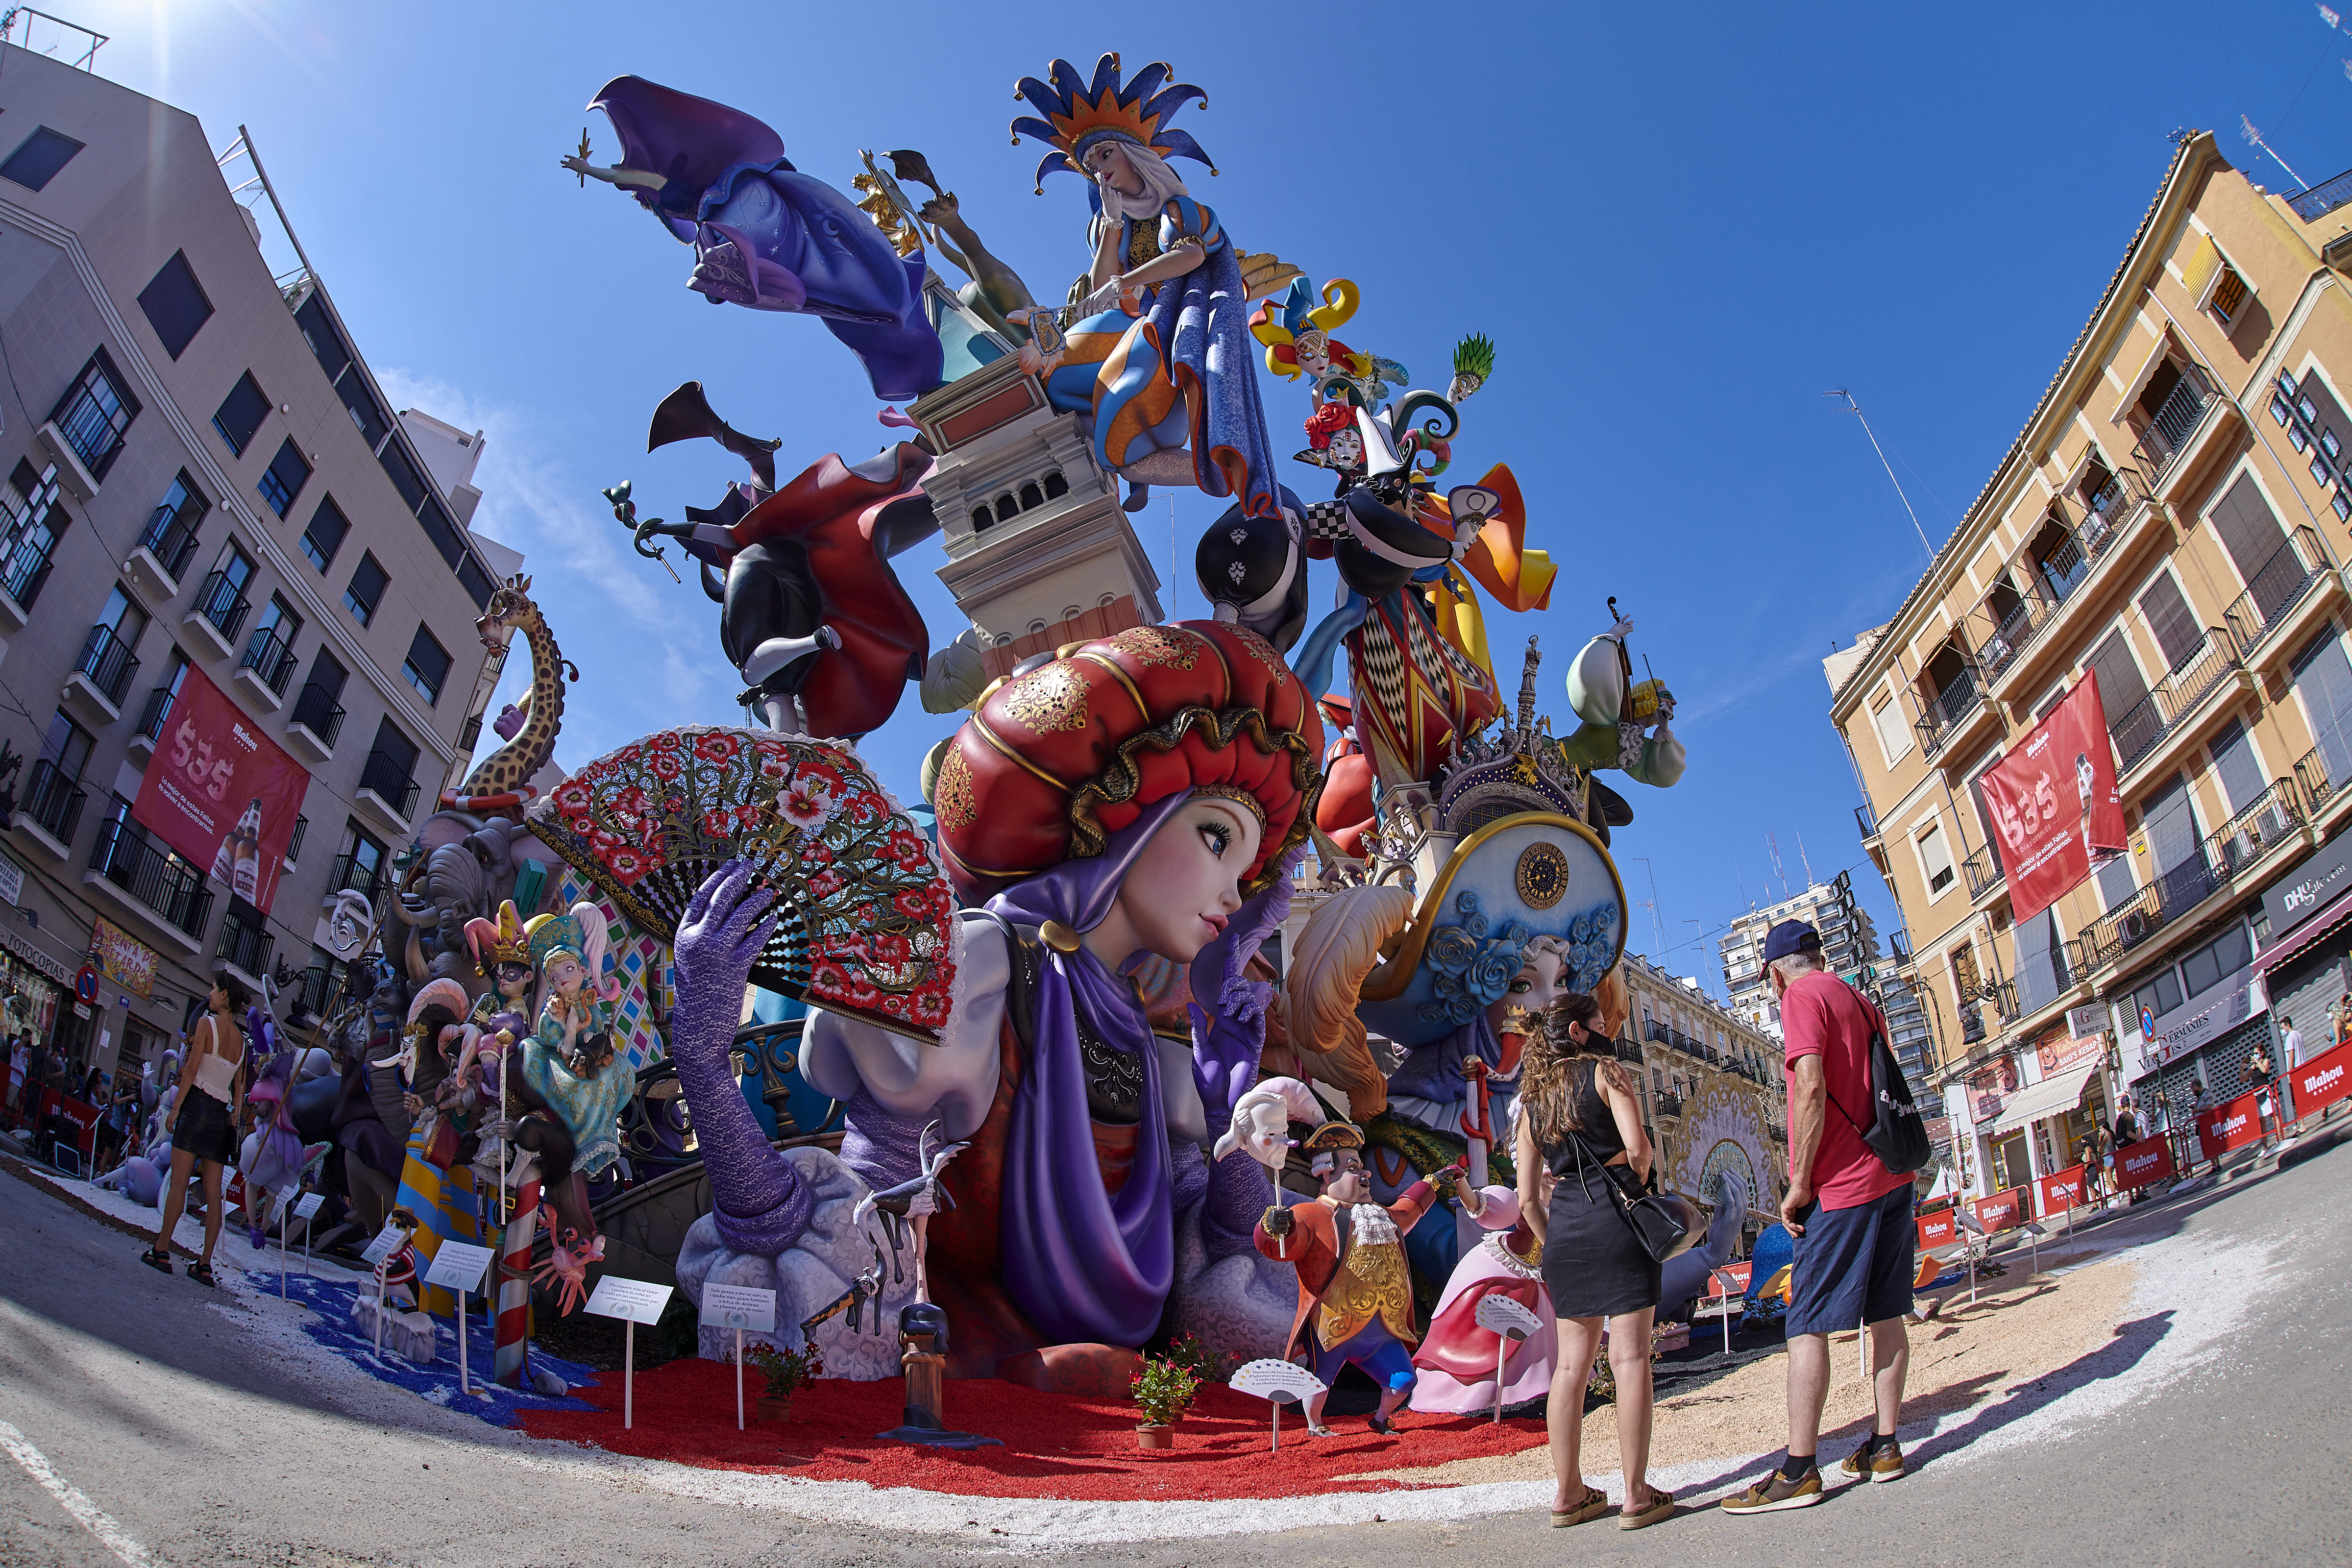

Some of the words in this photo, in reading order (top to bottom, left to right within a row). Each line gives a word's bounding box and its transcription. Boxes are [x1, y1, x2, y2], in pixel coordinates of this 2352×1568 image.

[233, 723, 257, 751] Mahou
[2027, 731, 2049, 758] Mahou
[171, 717, 233, 801] 535
[174, 770, 185, 784] DÍAS
[187, 782, 207, 803] DESPUÉS
[163, 787, 177, 805] volver
[181, 805, 214, 835] encontrarnos.
[167, 781, 180, 797] mejor
[180, 793, 187, 803] de
[187, 800, 200, 814] estas
[200, 810, 214, 826] Fallas
[2002, 771, 2058, 848] 535
[2016, 864, 2021, 874] Lo
[2021, 855, 2035, 871] mejor
[2035, 849, 2041, 858] de
[2041, 841, 2053, 856] estas
[2053, 829, 2068, 847] Fallas
[2020, 841, 2033, 853] DÍAS
[2032, 824, 2052, 844] DESPUÉS
[2022, 864, 2036, 880] volver
[2040, 838, 2073, 864] encontrarnos.
[260, 856, 277, 906] #lasfallasdelencuentro
[2283, 863, 2346, 911] DHgate.com
[8, 934, 65, 980] FOTOCOPIAS
[103, 944, 155, 982] PETARDOS
[109, 929, 139, 957] VENTA
[142, 950, 156, 967] DE
[2056, 1039, 2082, 1055] Kebap
[2059, 1051, 2078, 1066] BAIG'S
[2079, 1041, 2097, 1056] KEBAP
[2304, 1065, 2344, 1093] Mahou
[2004, 1094, 2018, 1105] LLEVAR
[2211, 1114, 2247, 1137] Mahou
[2126, 1152, 2158, 1172] Mahou
[2051, 1181, 2078, 1198] Mahou
[1983, 1203, 2011, 1220] Mahou
[1925, 1223, 1947, 1235] Mahou
